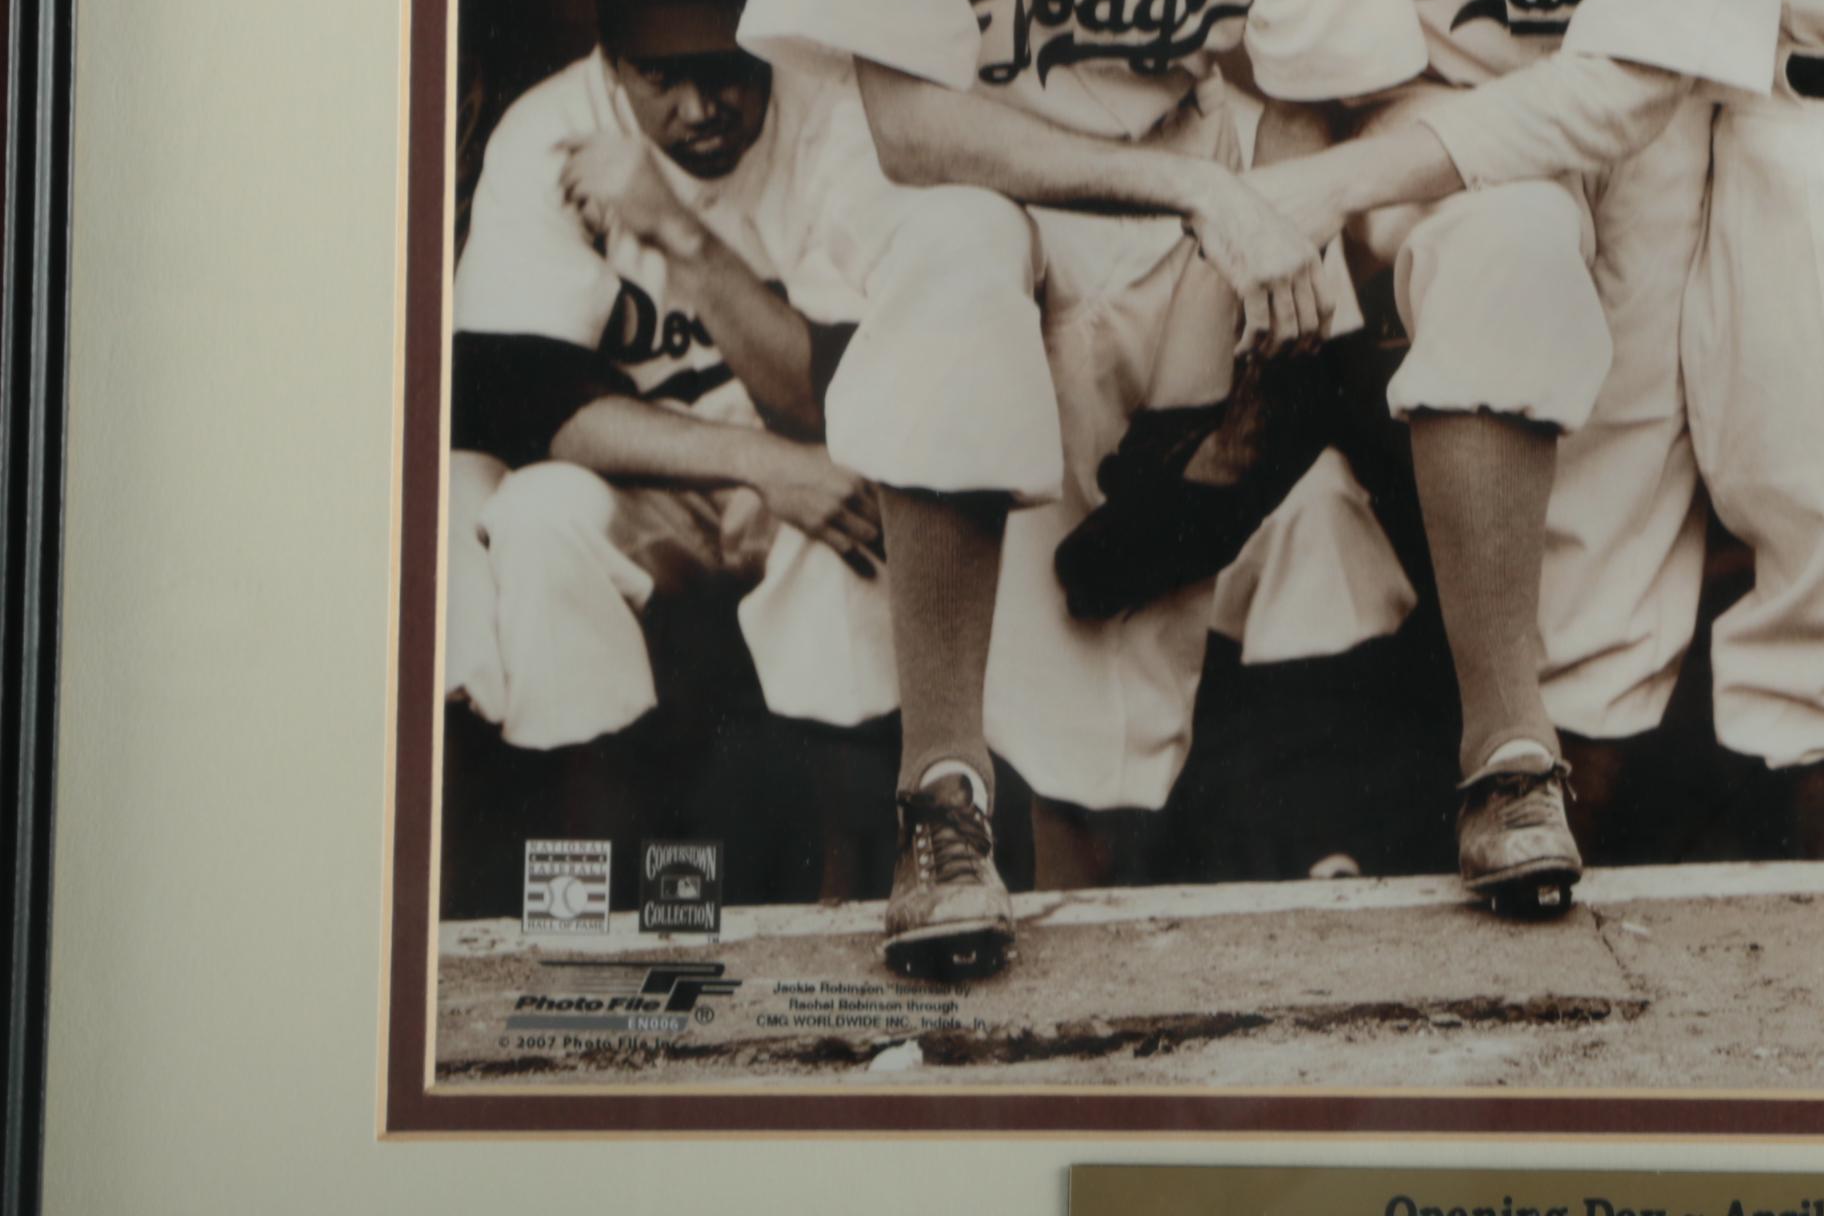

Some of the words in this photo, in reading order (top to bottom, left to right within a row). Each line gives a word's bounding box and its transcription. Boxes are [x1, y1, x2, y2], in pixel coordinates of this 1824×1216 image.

[643, 900, 715, 929] COLLECTION
[773, 981, 815, 995] Jackie
[514, 995, 604, 1012] Photo
[606, 996, 661, 1012] File
[789, 998, 834, 1012] Rachel
[838, 999, 902, 1012] Robinson
[906, 999, 959, 1016] through
[628, 1016, 680, 1031] EN006
[756, 1015, 789, 1028] CMG
[793, 1015, 881, 1029] WORLDWIDE
[516, 1036, 556, 1049] 2007
[562, 1036, 612, 1050] Photo
